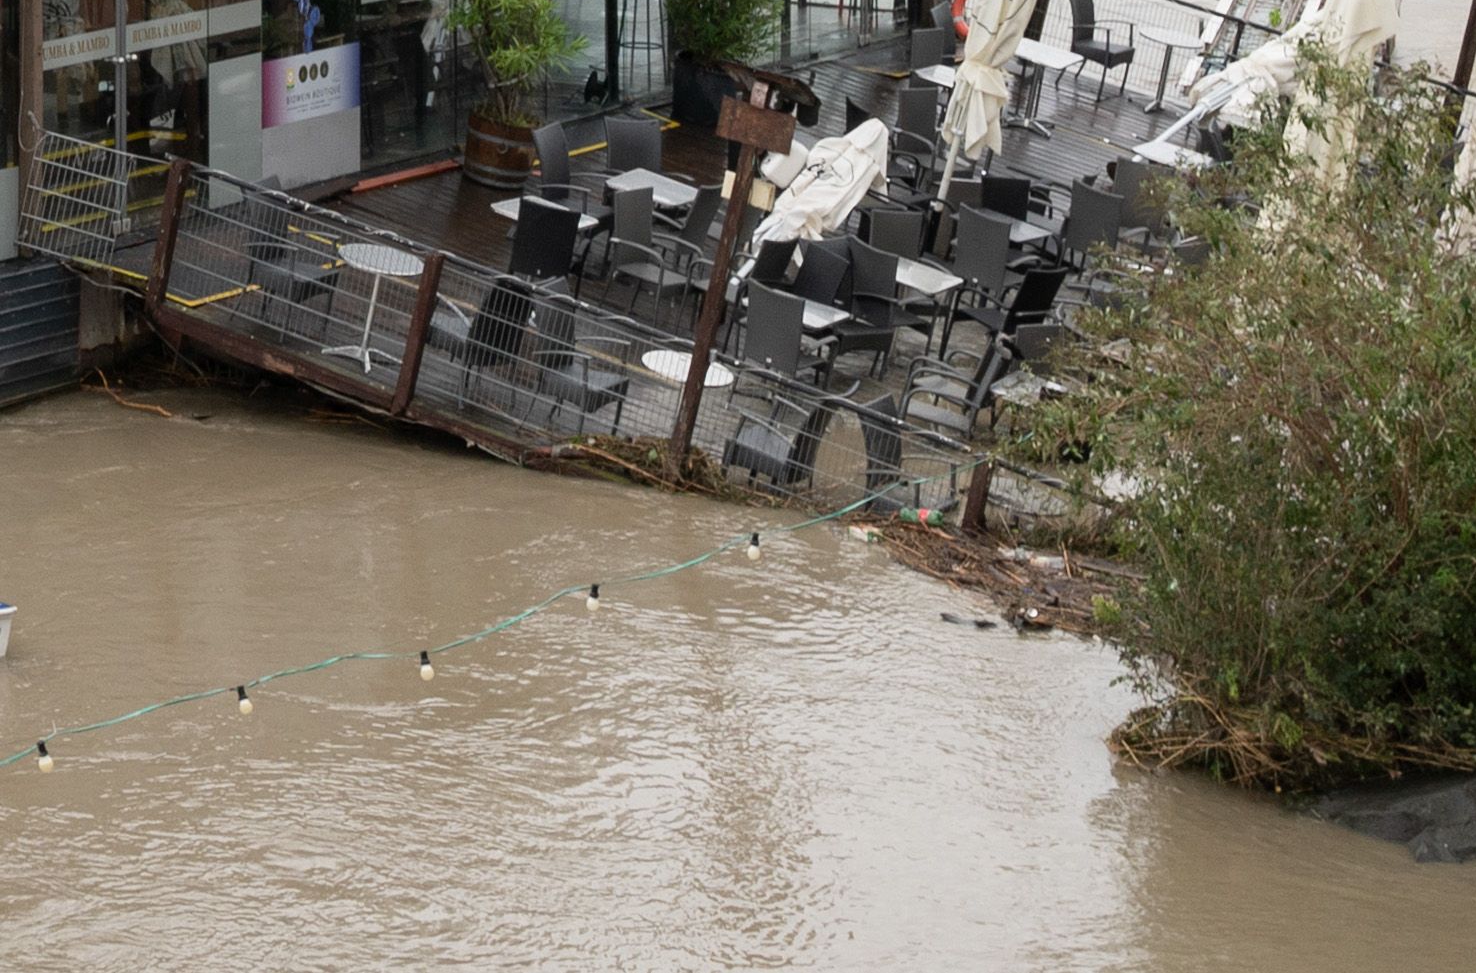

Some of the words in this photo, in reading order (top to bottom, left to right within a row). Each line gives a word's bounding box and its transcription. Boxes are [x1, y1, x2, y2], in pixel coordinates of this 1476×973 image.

[132, 25, 163, 44] RUMBA
[170, 19, 203, 37] MAMBO
[43, 44, 68, 62] UMBA
[76, 35, 111, 54] MAMBO
